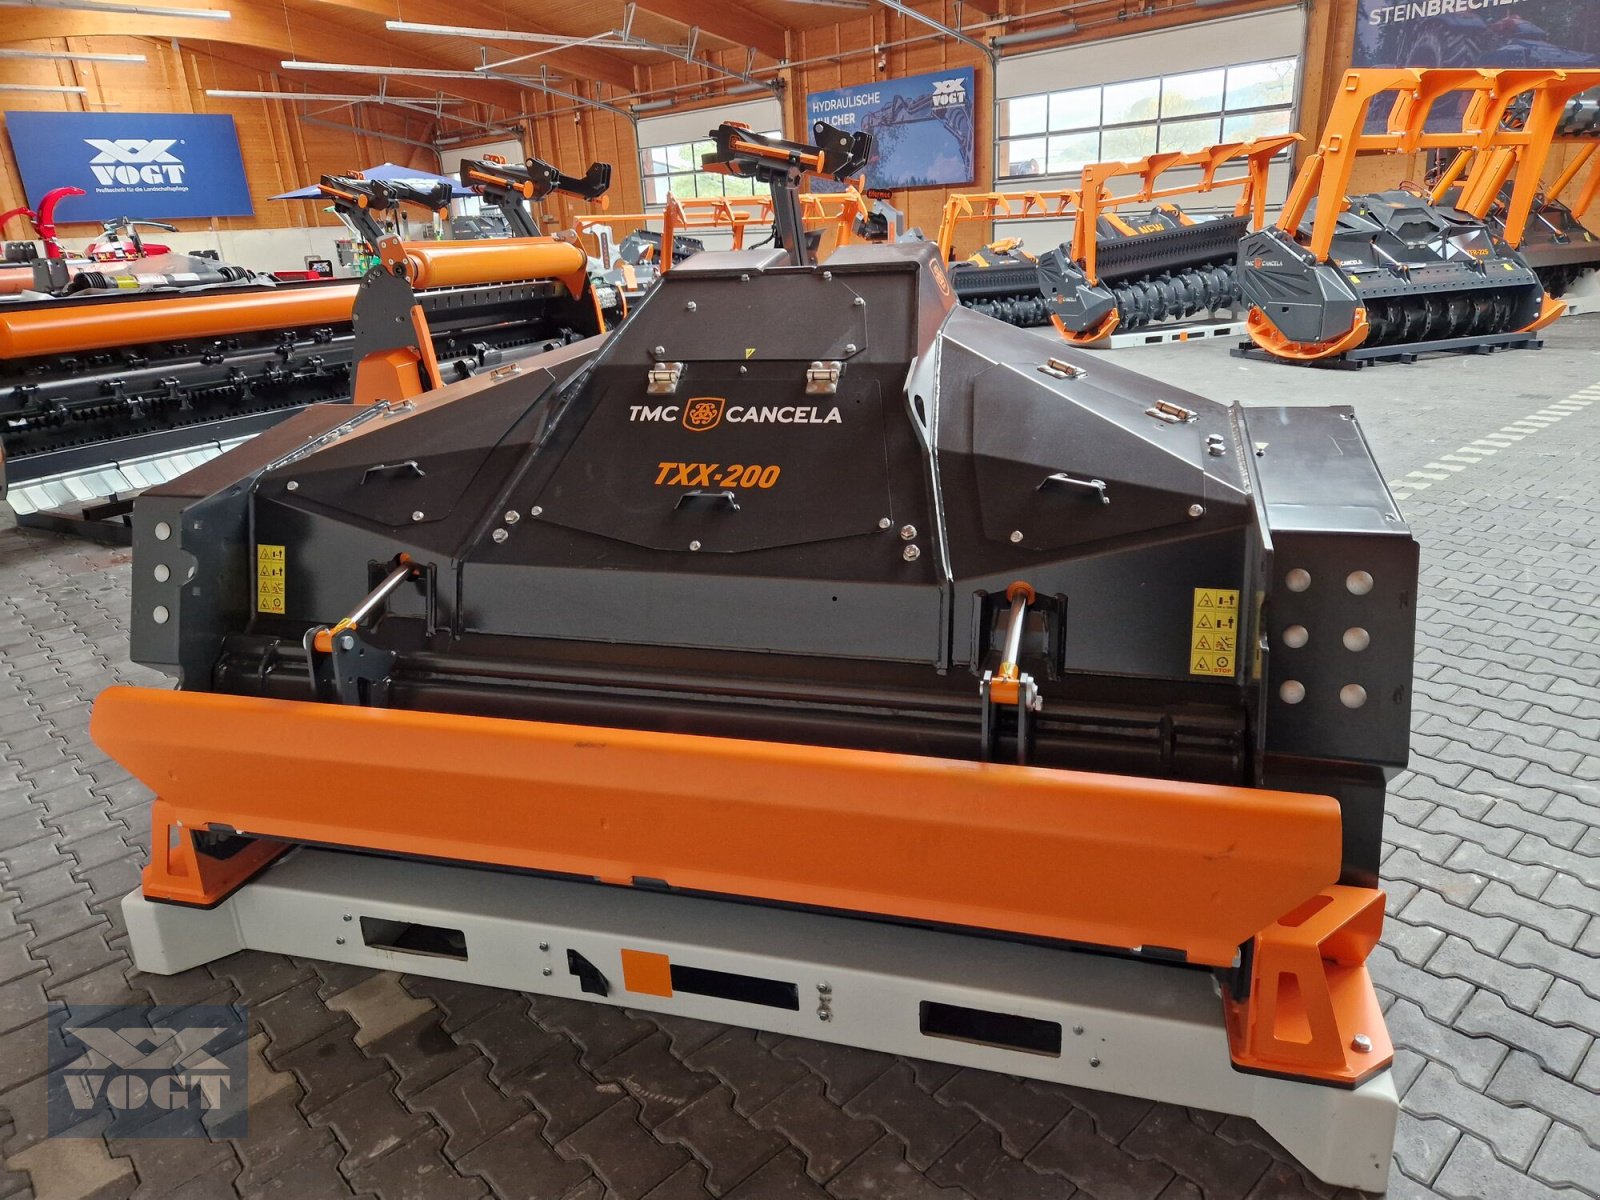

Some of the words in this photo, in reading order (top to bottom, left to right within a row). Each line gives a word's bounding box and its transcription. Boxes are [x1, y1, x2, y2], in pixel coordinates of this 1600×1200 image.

[1369, 0, 1527, 26] STEINBRECH
[812, 92, 881, 113] HYDRAULISCHE
[932, 91, 966, 107] VOGT
[90, 165, 186, 186] VOGT
[629, 405, 680, 422] TMC
[725, 406, 843, 424] CANCELA
[654, 462, 781, 488] TXX-200
